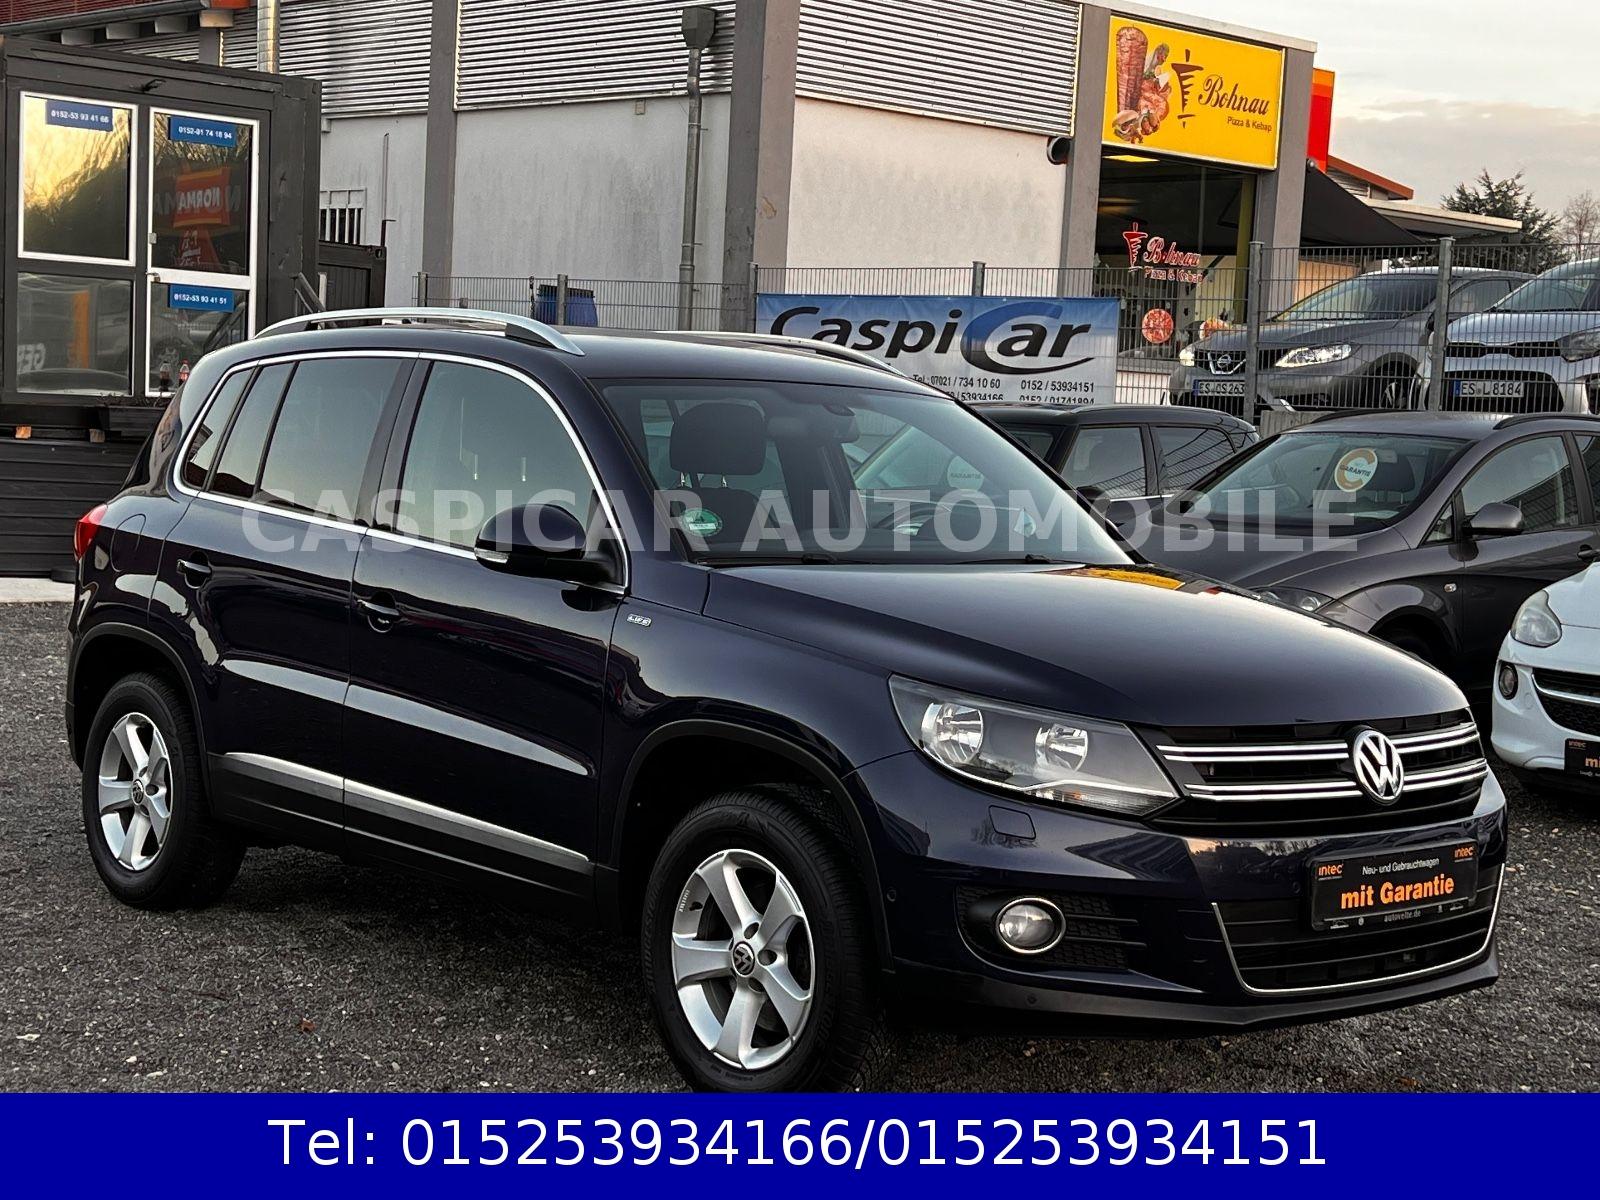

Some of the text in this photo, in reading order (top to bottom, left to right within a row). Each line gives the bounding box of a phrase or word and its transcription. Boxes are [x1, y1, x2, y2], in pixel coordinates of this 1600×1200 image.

[1198, 74, 1269, 115] Bohnau
[1227, 116, 1272, 133] Pizza & Kebap
[205, 128, 214, 137] 74
[219, 297, 227, 305] 51
[931, 376, 951, 386] 07021
[959, 377, 974, 387] 734
[977, 378, 988, 388] 10
[990, 378, 1001, 389] 60
[1021, 380, 1042, 390] 0152
[1051, 381, 1094, 393] 53934151
[1462, 383, 1521, 395] ES L 8184
[1454, 846, 1474, 859] intec
[1318, 863, 1343, 876] intec
[1362, 858, 1440, 875] Neu- und Gebrauchtwagen
[1340, 873, 1455, 909] mit Garantie
